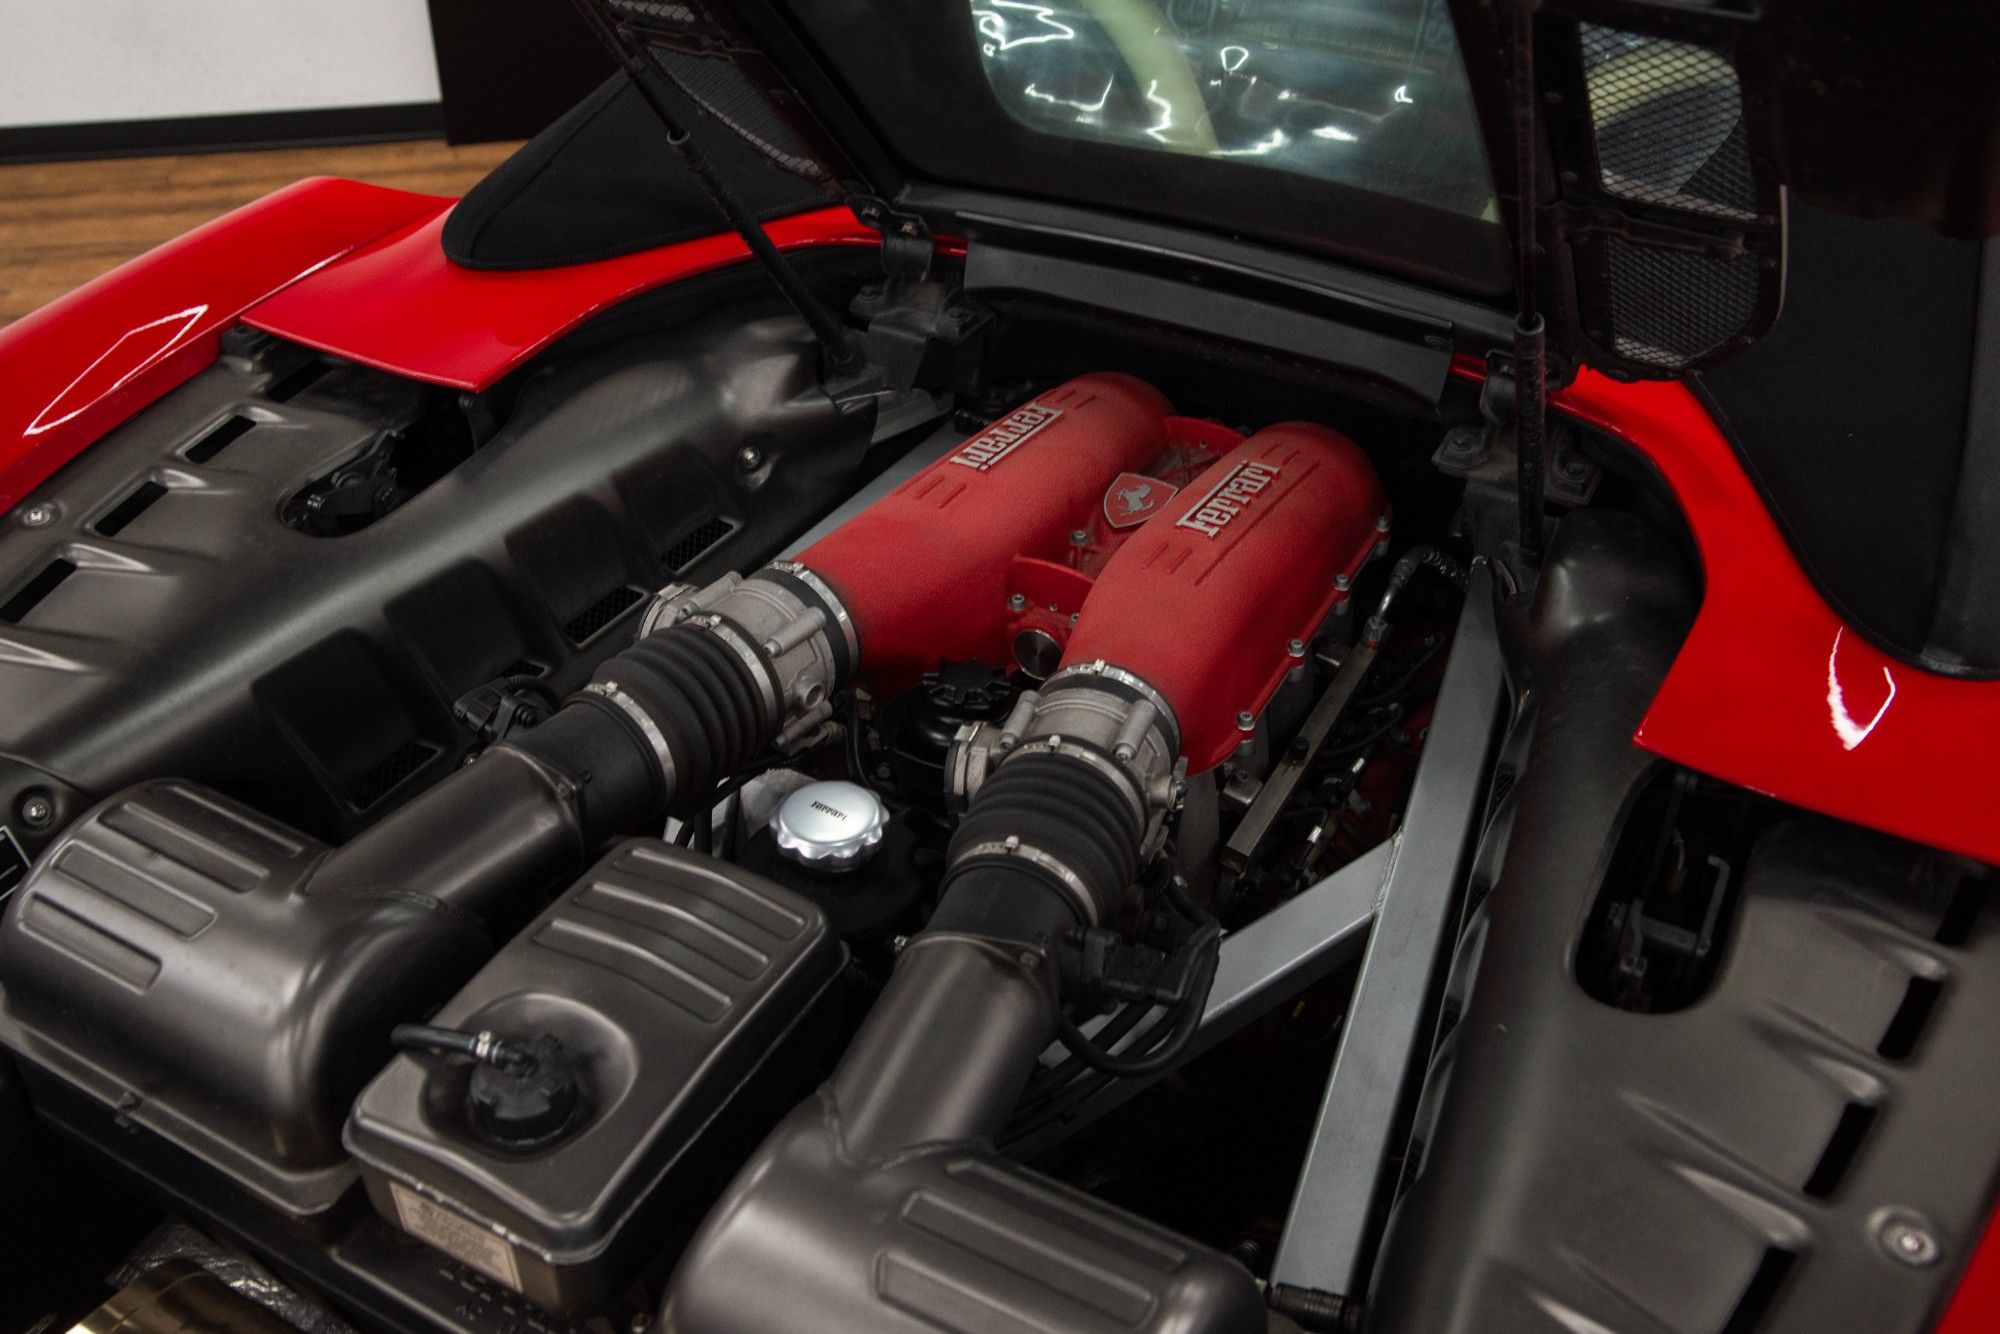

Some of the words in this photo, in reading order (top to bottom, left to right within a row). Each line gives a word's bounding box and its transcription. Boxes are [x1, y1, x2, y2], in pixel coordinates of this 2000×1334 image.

[951, 403, 1064, 470] Ferrari
[1177, 460, 1281, 537] Ferrari
[810, 801, 848, 821] Ferrari
